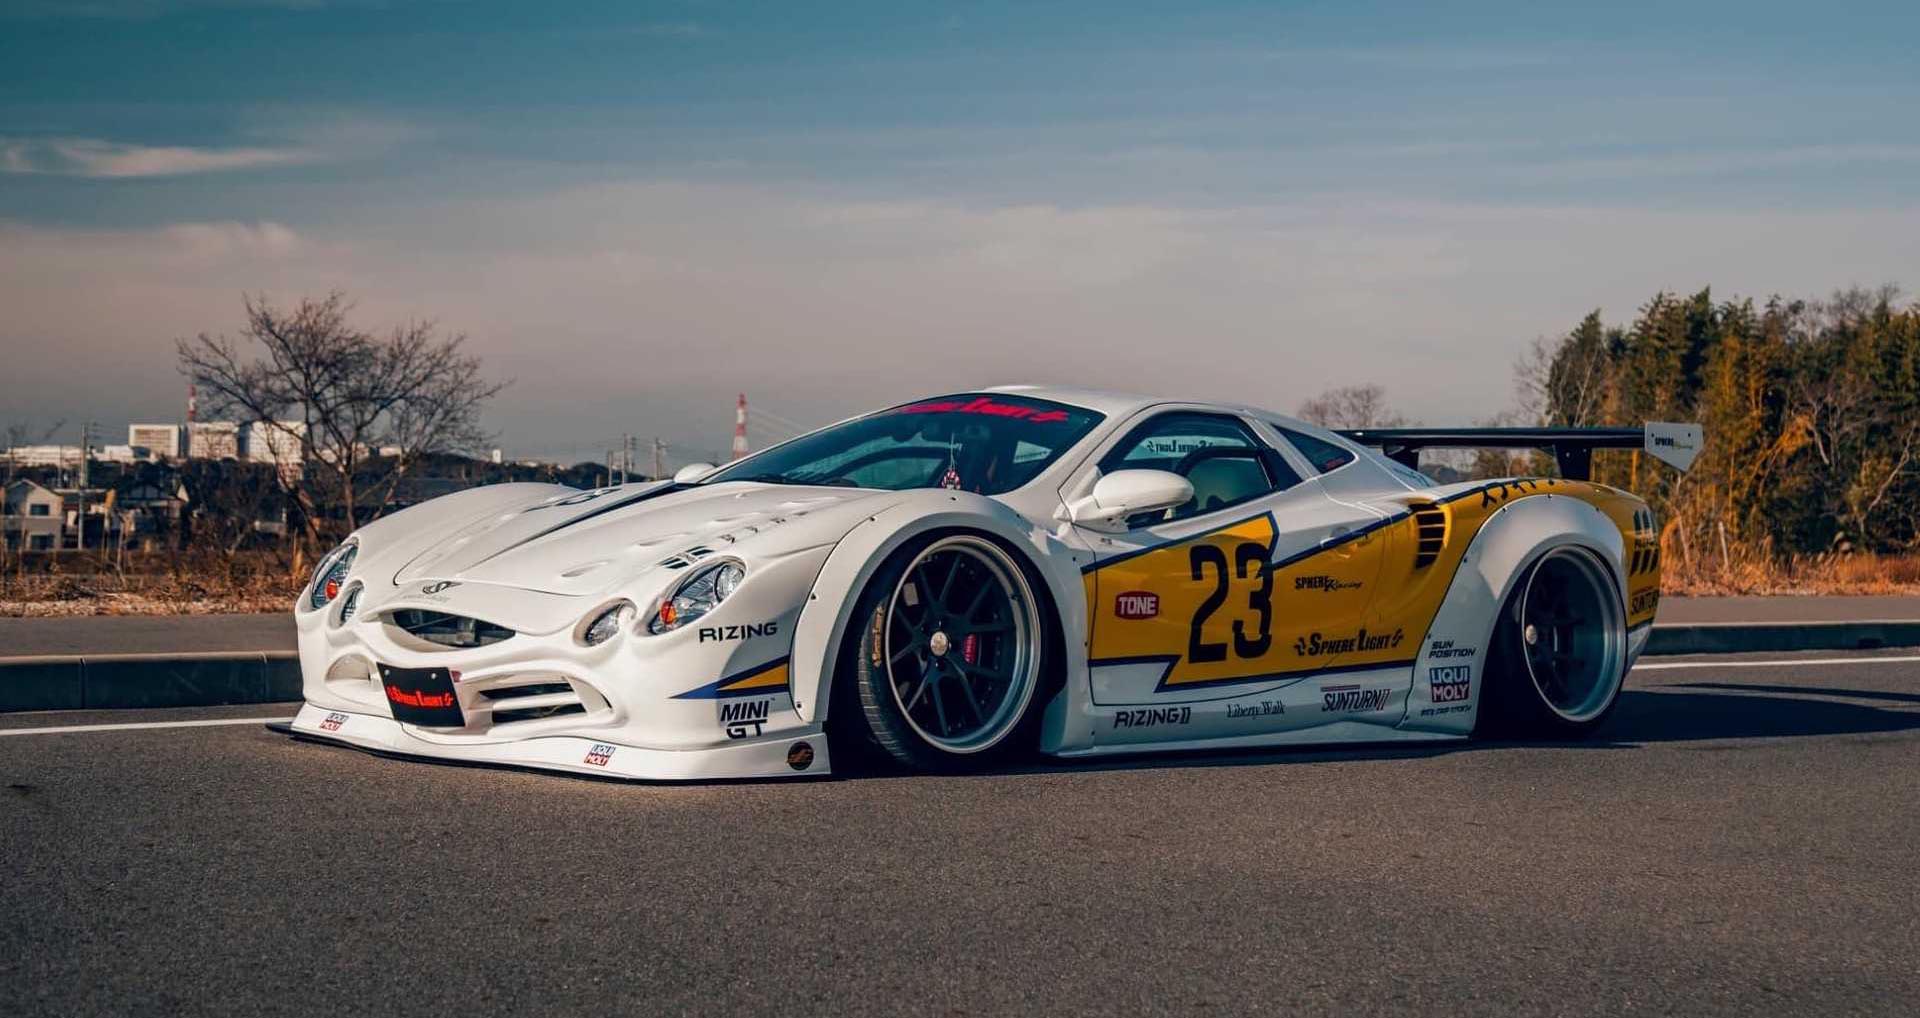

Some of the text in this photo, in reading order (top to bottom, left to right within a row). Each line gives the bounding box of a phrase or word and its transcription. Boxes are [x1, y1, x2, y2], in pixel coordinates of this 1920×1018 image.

[1119, 597, 1156, 615] TONE
[1189, 543, 1274, 663] 23
[700, 623, 778, 643] RIZING
[1429, 648, 1476, 659] POSITION
[1432, 640, 1454, 650] SUN
[1431, 667, 1469, 684] LIQUI
[1433, 685, 1469, 701] MOLY
[720, 700, 770, 722] MINI
[726, 719, 768, 739] GT
